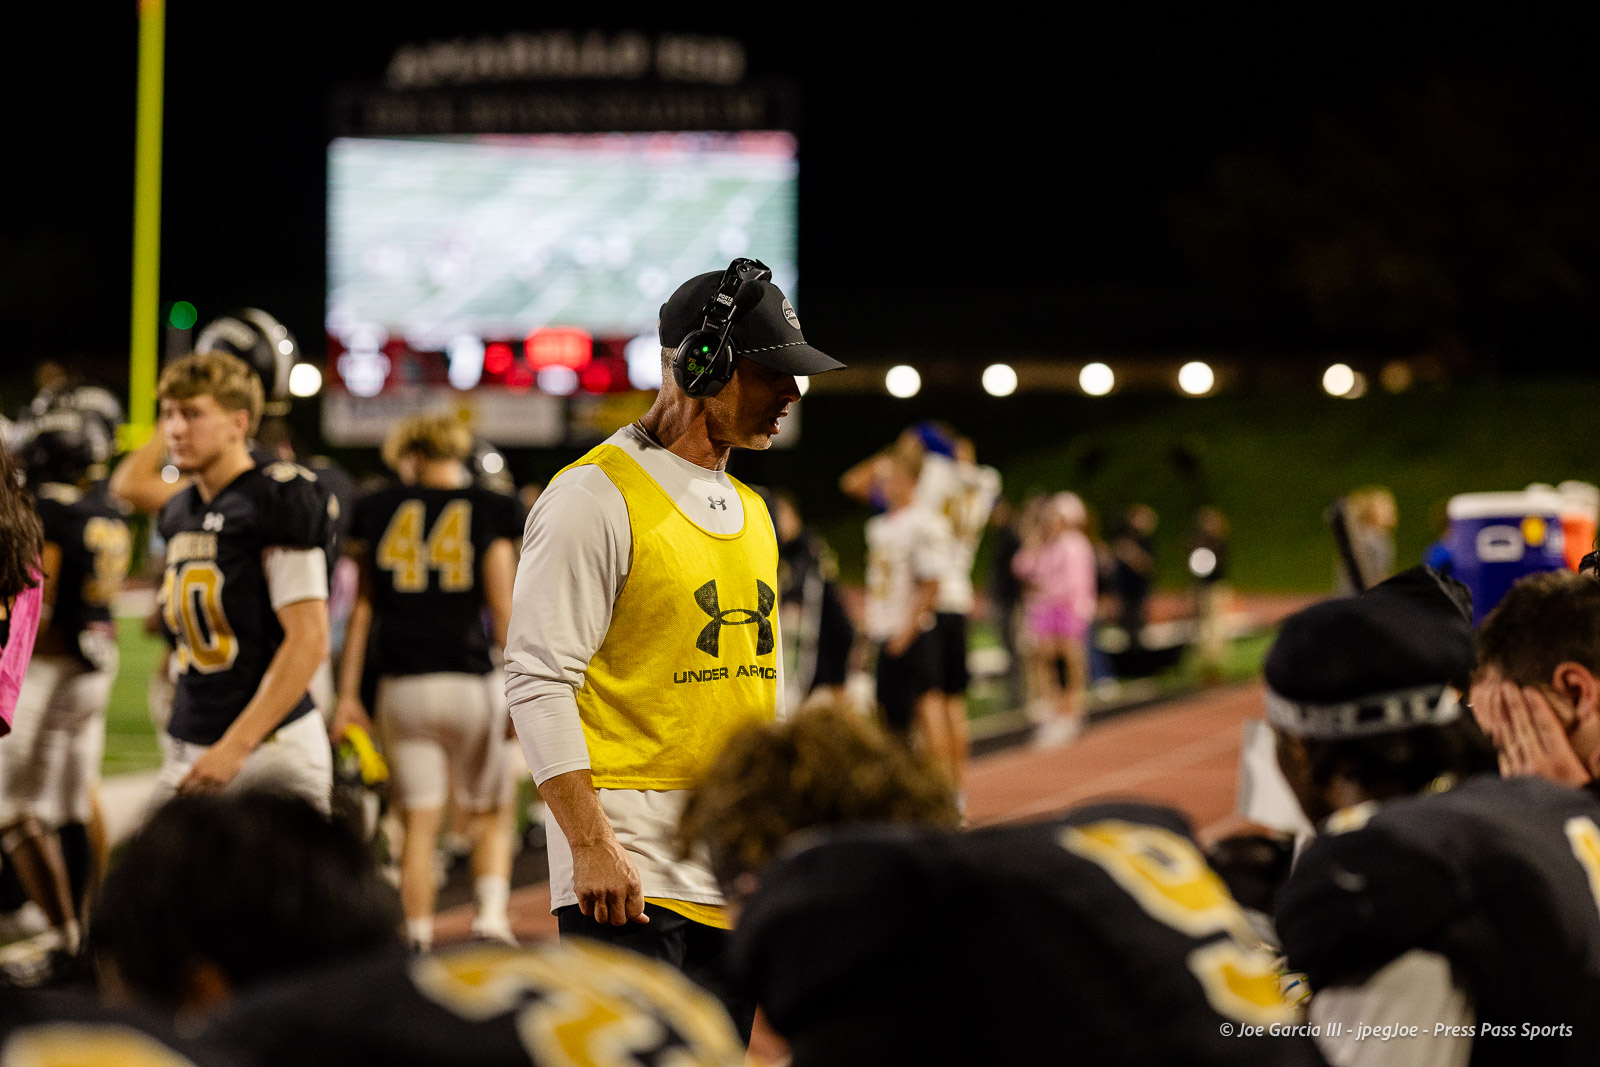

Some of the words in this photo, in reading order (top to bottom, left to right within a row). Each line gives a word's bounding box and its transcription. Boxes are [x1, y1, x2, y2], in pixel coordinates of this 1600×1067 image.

[377, 499, 475, 592] 44
[673, 667, 729, 684] UNDER
[735, 665, 777, 680] ARMO
